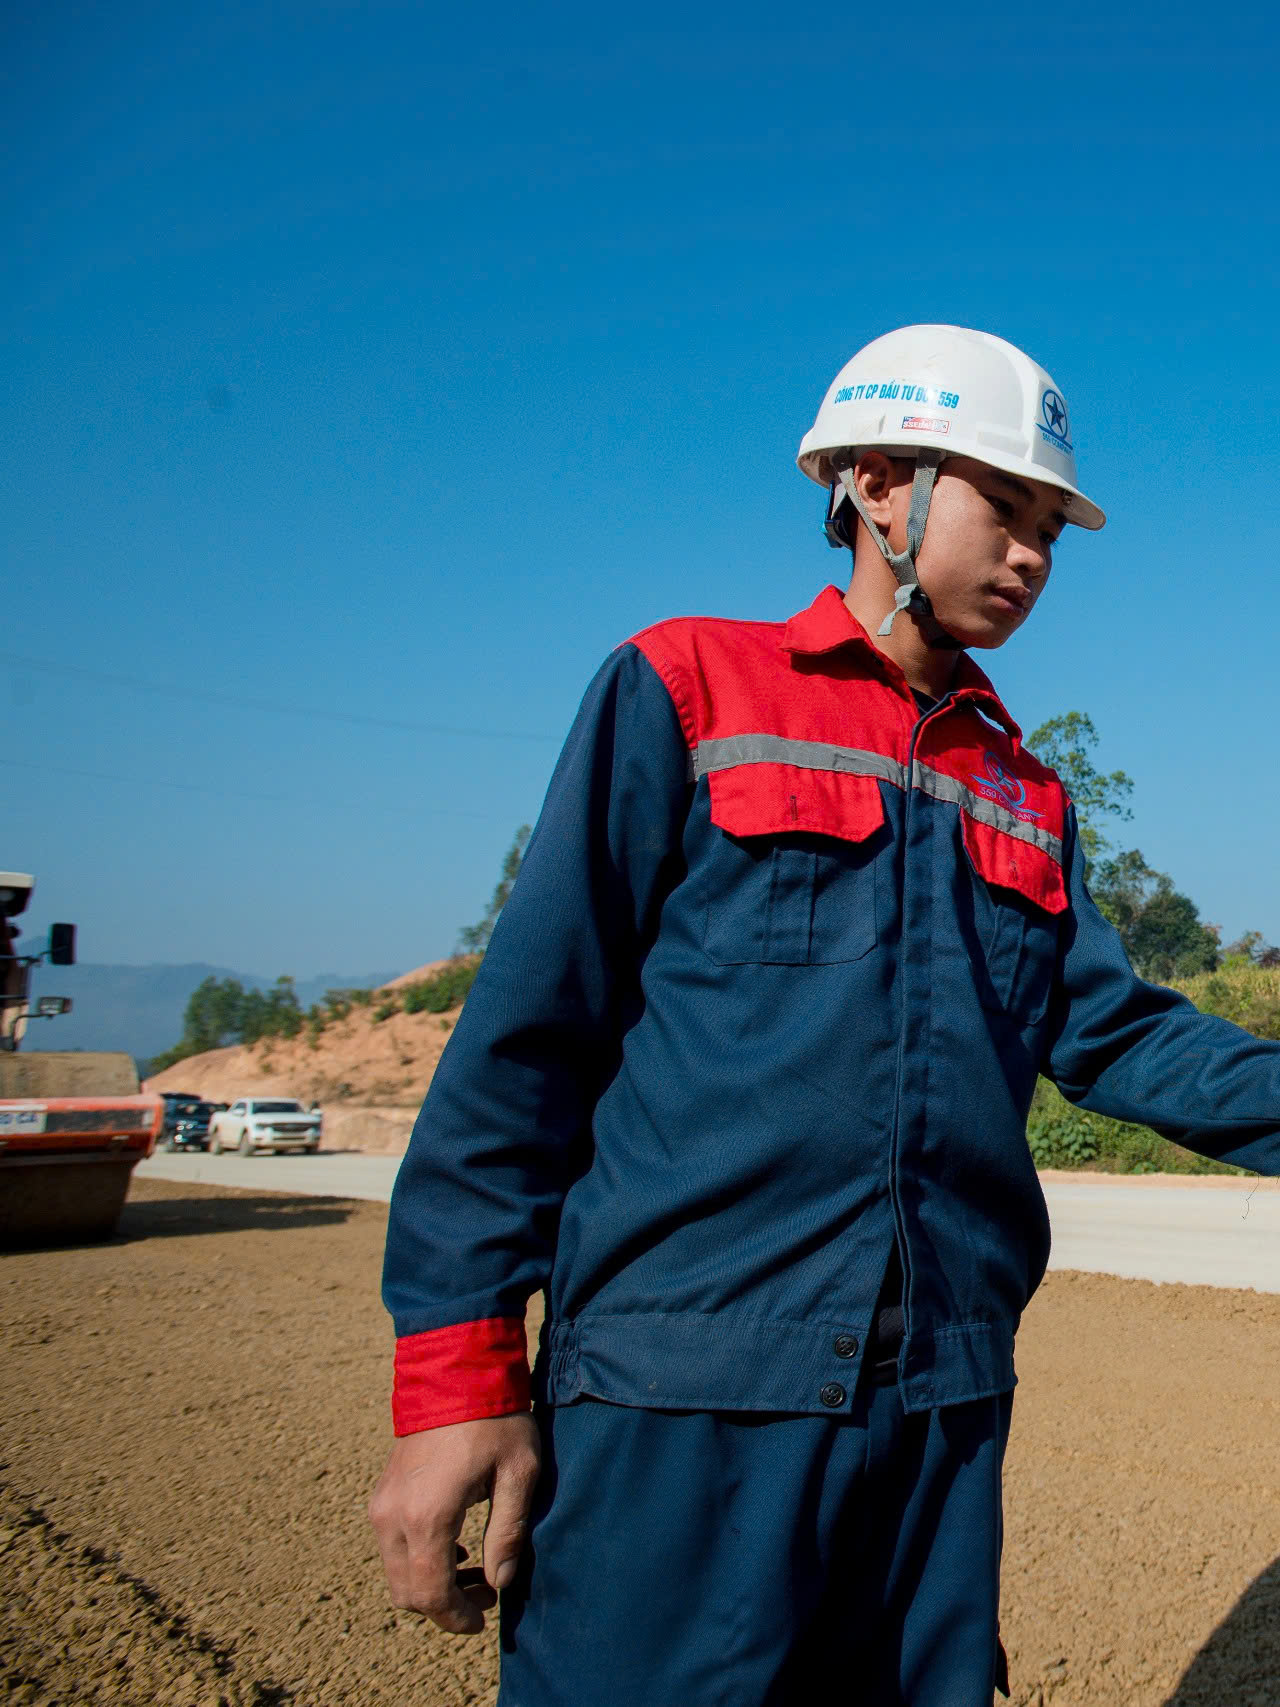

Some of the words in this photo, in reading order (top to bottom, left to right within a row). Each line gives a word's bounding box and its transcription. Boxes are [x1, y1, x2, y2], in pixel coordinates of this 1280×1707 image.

[854, 384, 866, 400] TY
[865, 384, 879, 399] CP
[937, 391, 960, 409] 559
[980, 786, 997, 799] 559
